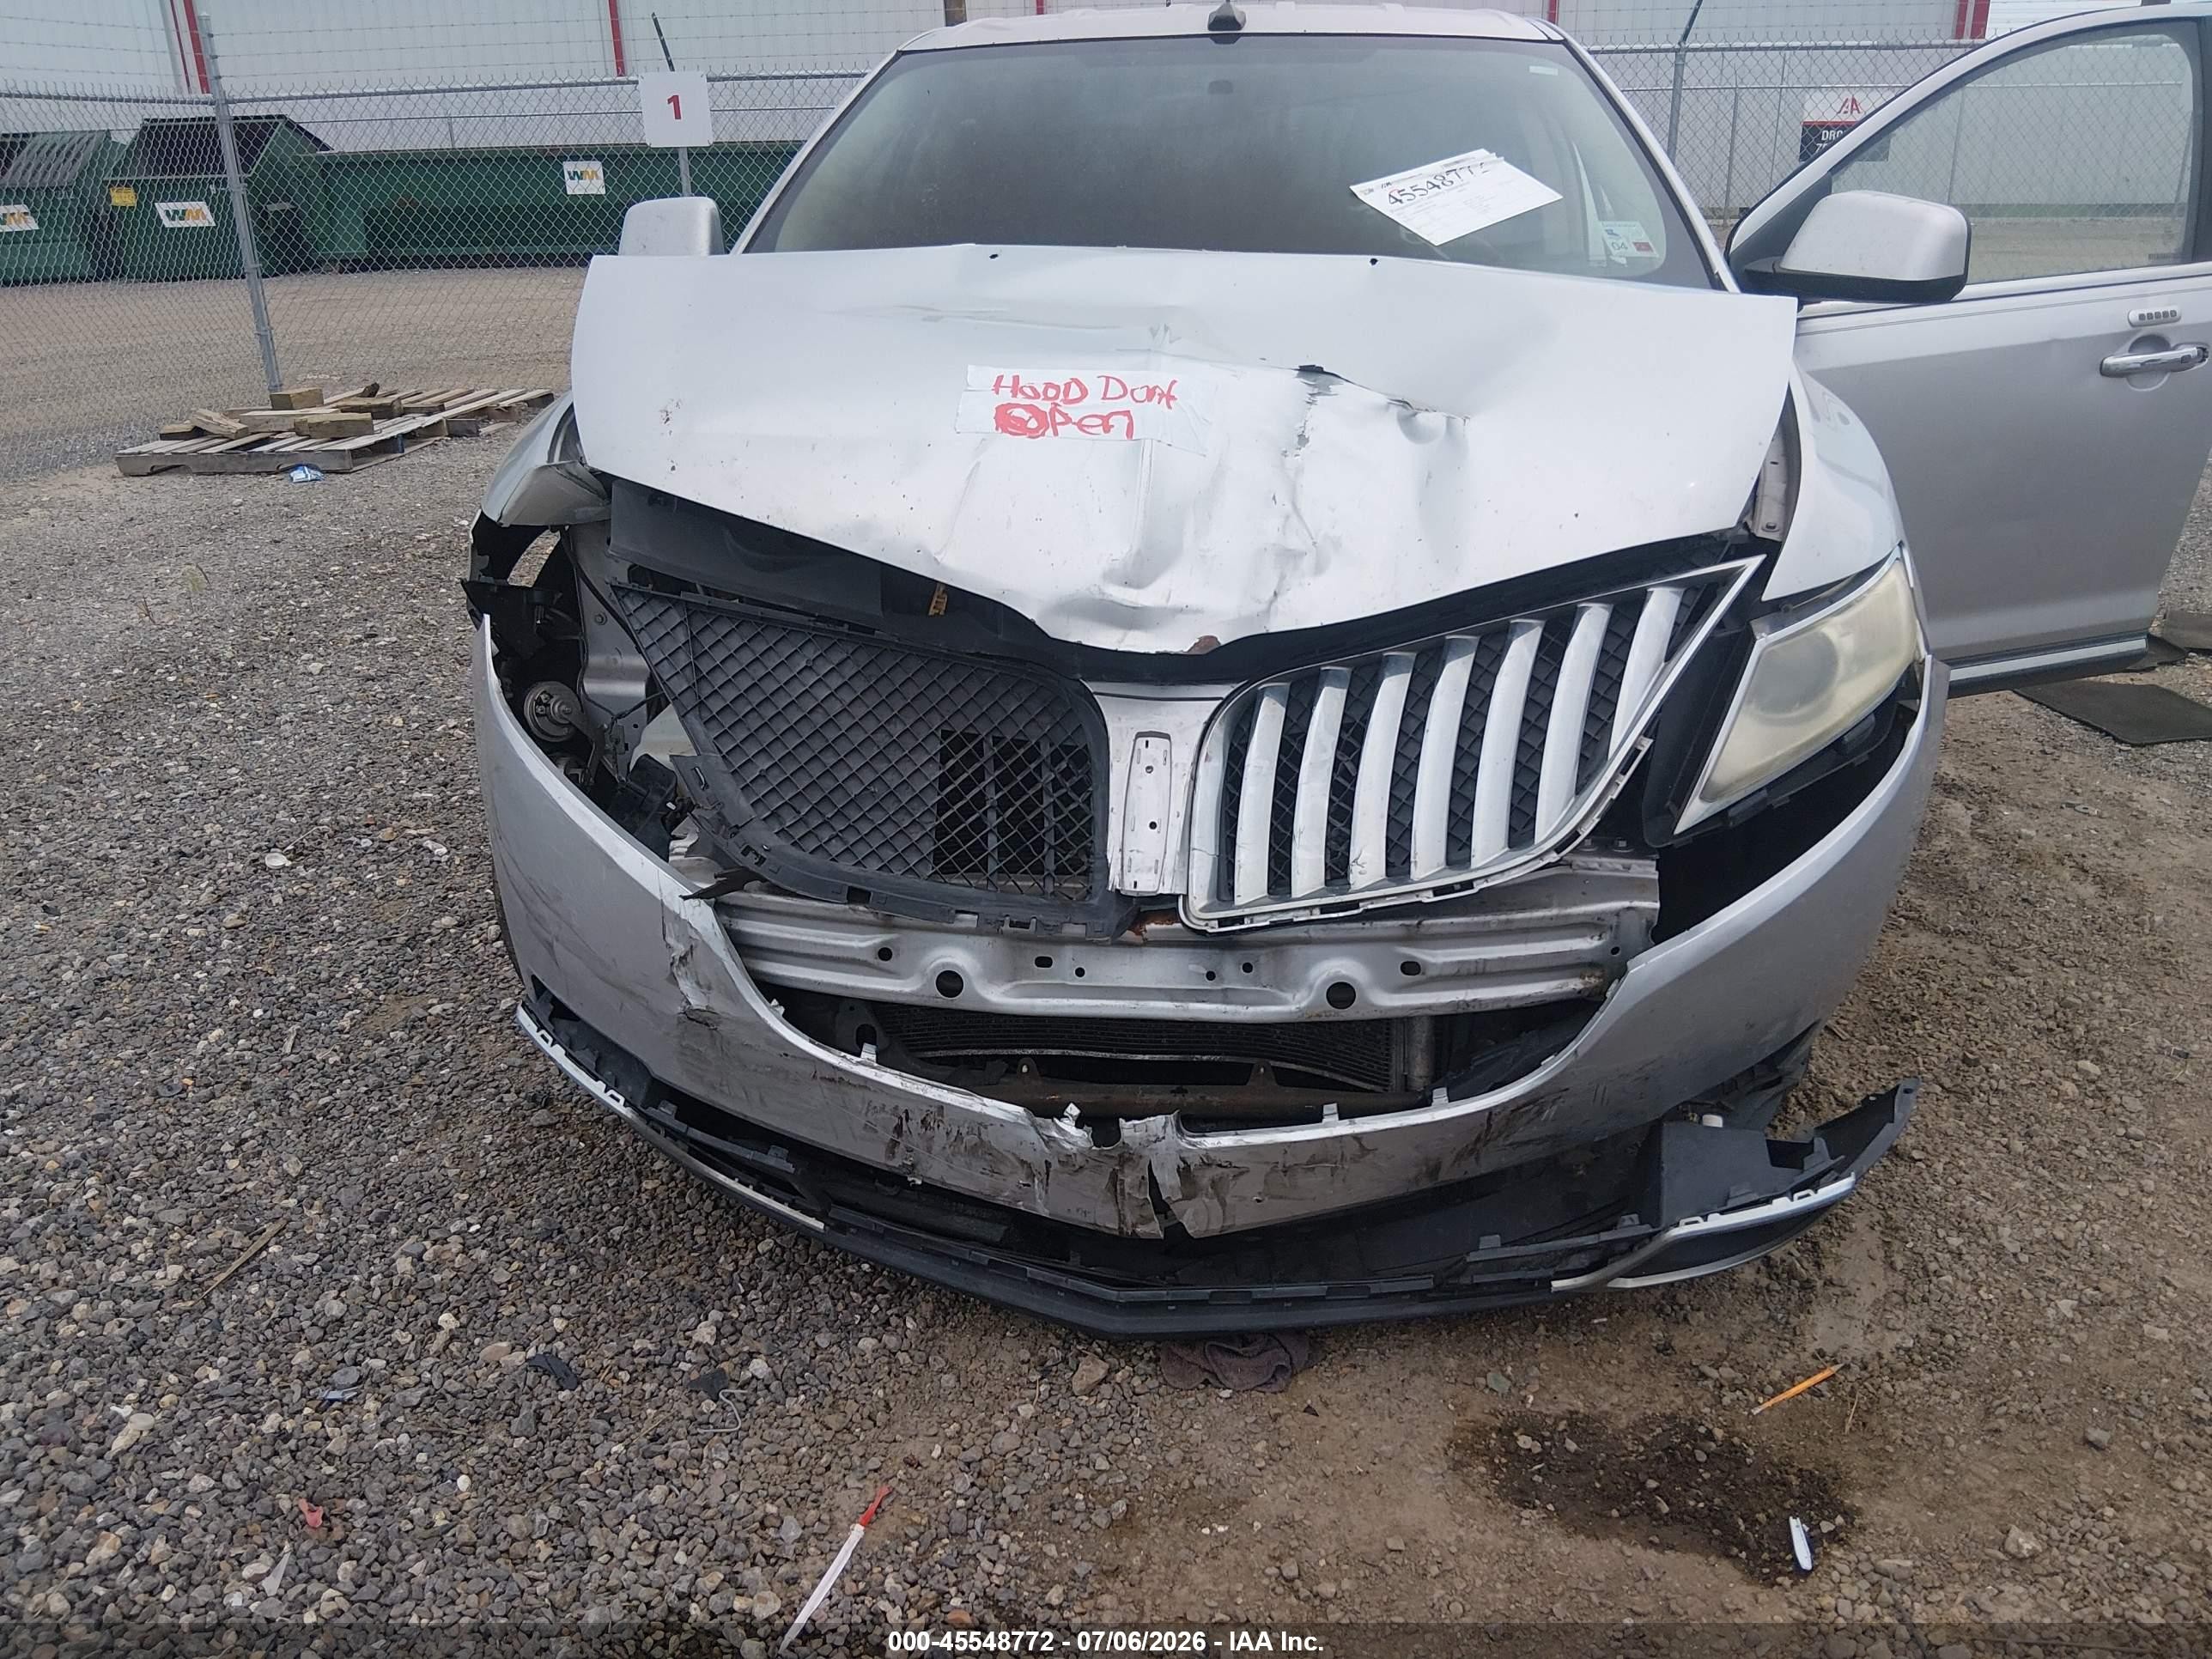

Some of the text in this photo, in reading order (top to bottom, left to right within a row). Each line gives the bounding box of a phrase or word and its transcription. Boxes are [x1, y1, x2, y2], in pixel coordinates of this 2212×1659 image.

[667, 94, 682, 120] 1
[1820, 130, 1846, 141] DRO
[567, 170, 599, 180] WM
[164, 208, 207, 222] WM
